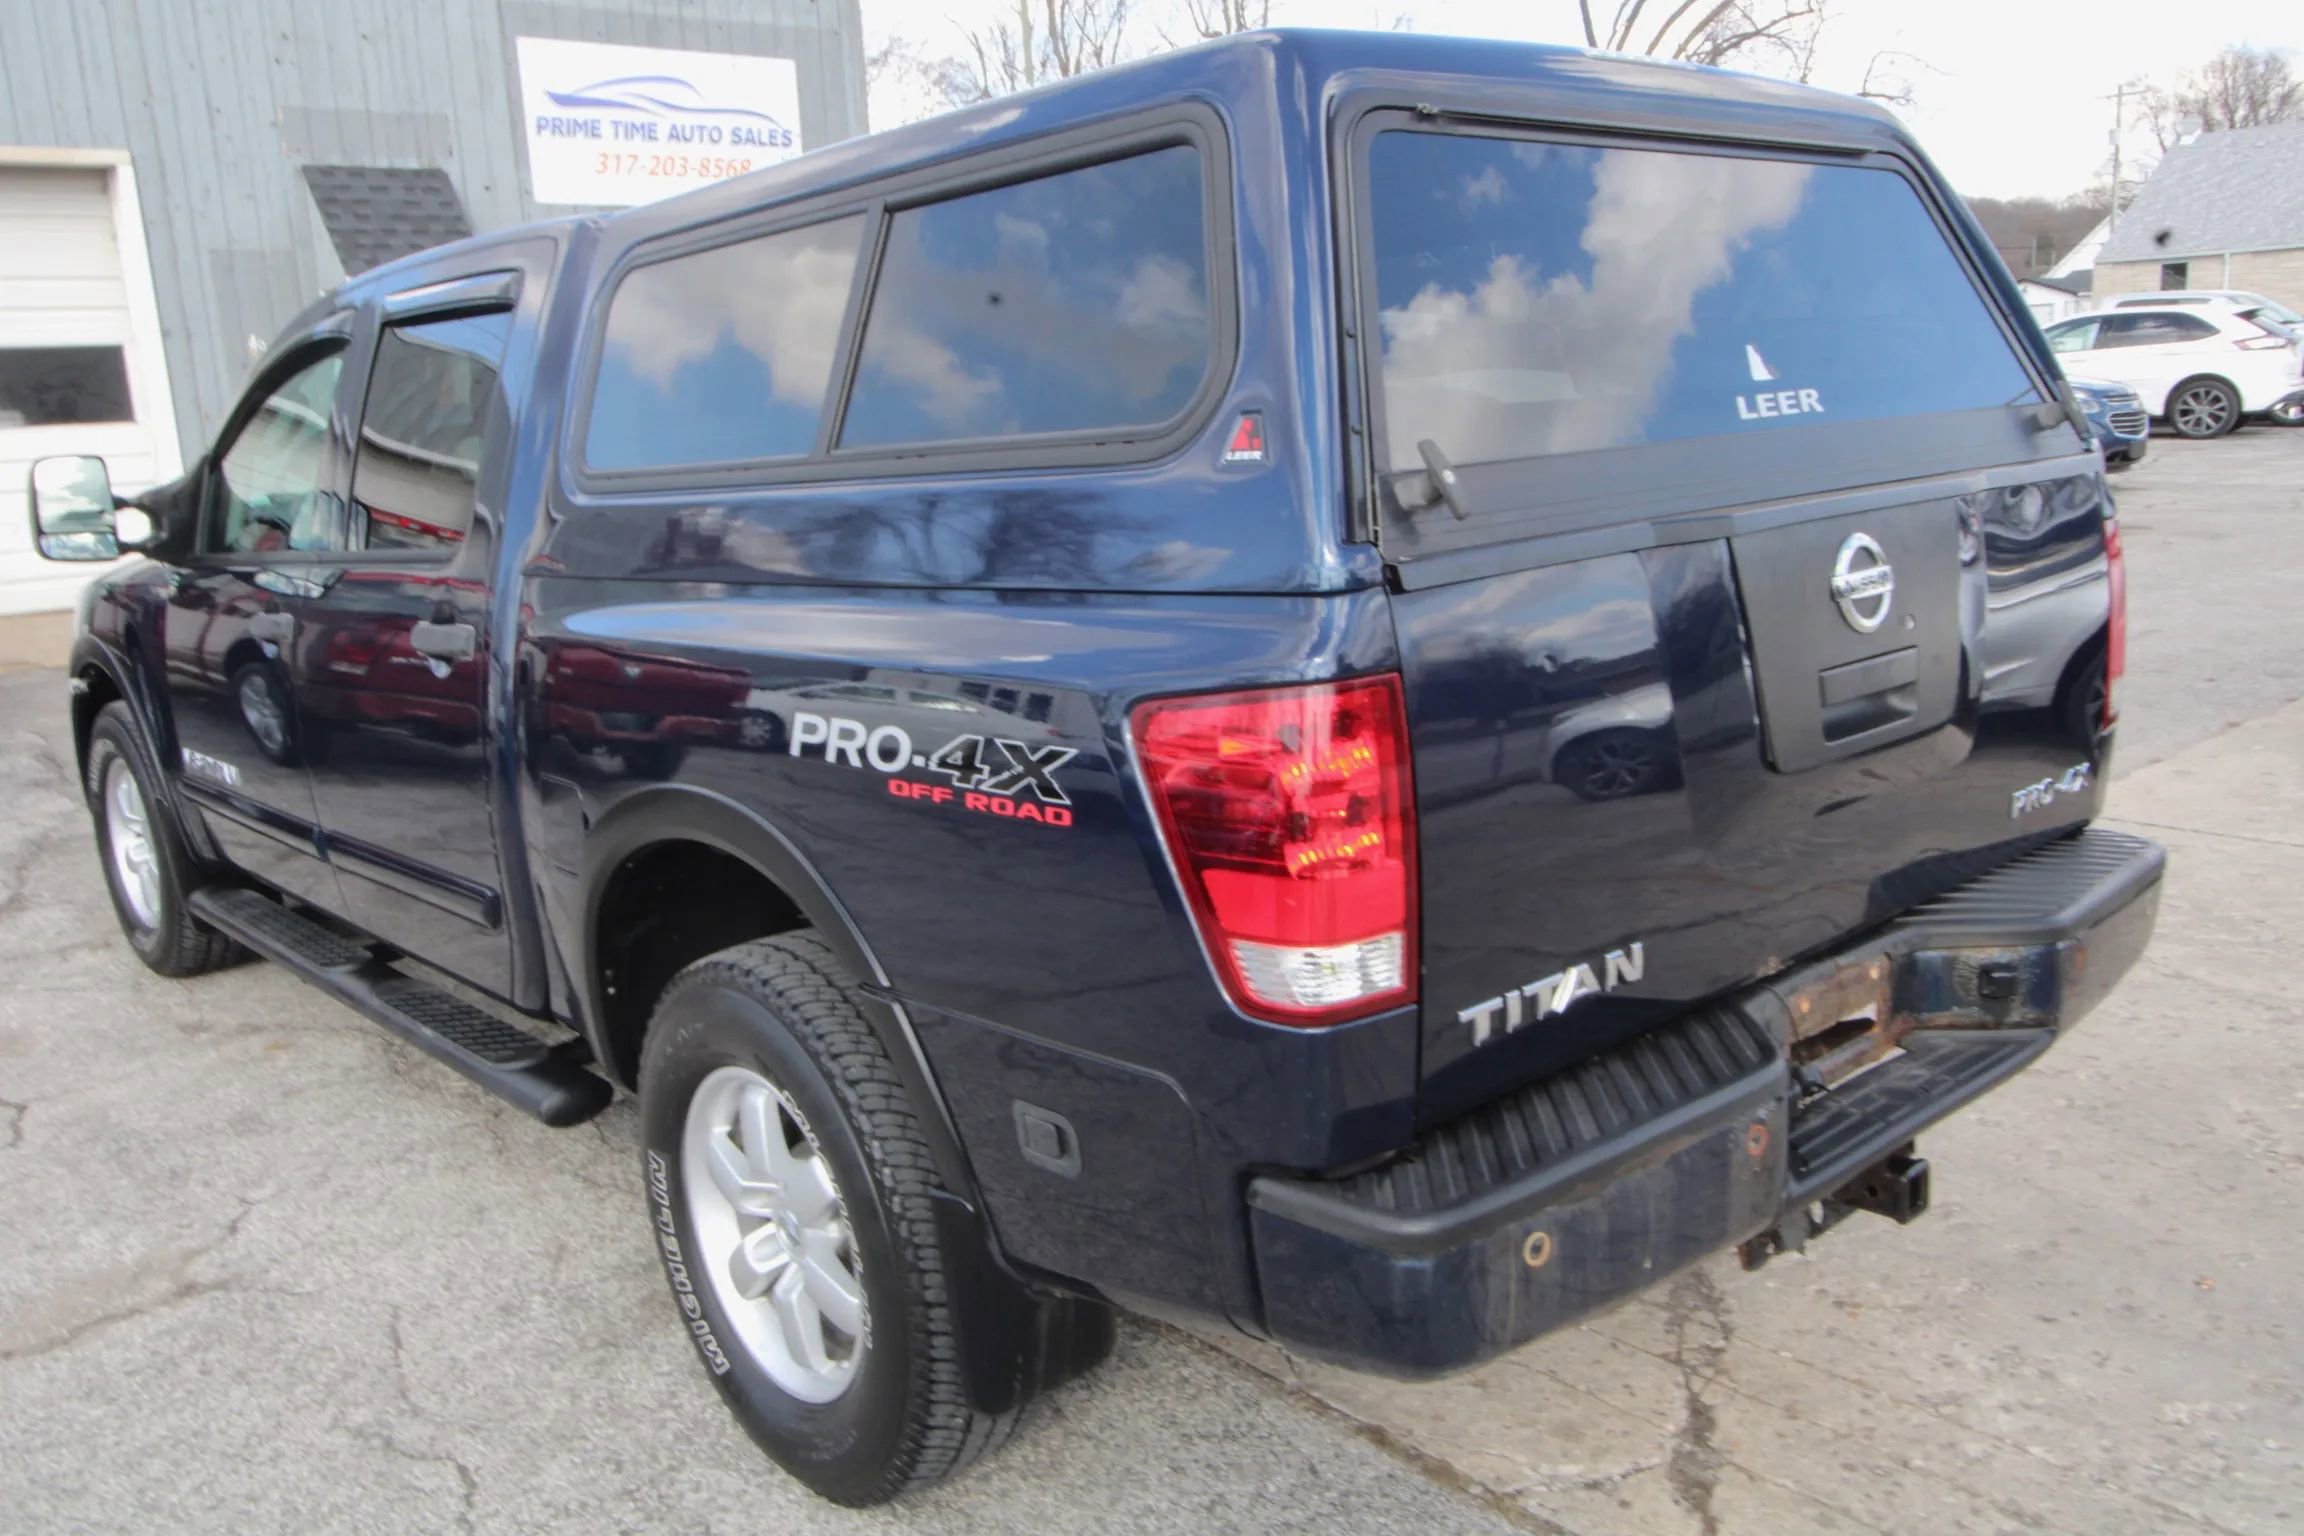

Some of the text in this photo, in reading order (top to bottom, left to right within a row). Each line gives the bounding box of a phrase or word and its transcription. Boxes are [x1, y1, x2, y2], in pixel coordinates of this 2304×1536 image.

[536, 116, 793, 147] PRIME TIME AUTO SALES
[595, 153, 751, 178] 317-203-8568
[1736, 388, 1825, 420] LEER
[888, 778, 1073, 827] OFF ROAD
[1457, 942, 1644, 1047] TITAN
[649, 1150, 730, 1376] MICHELIN
